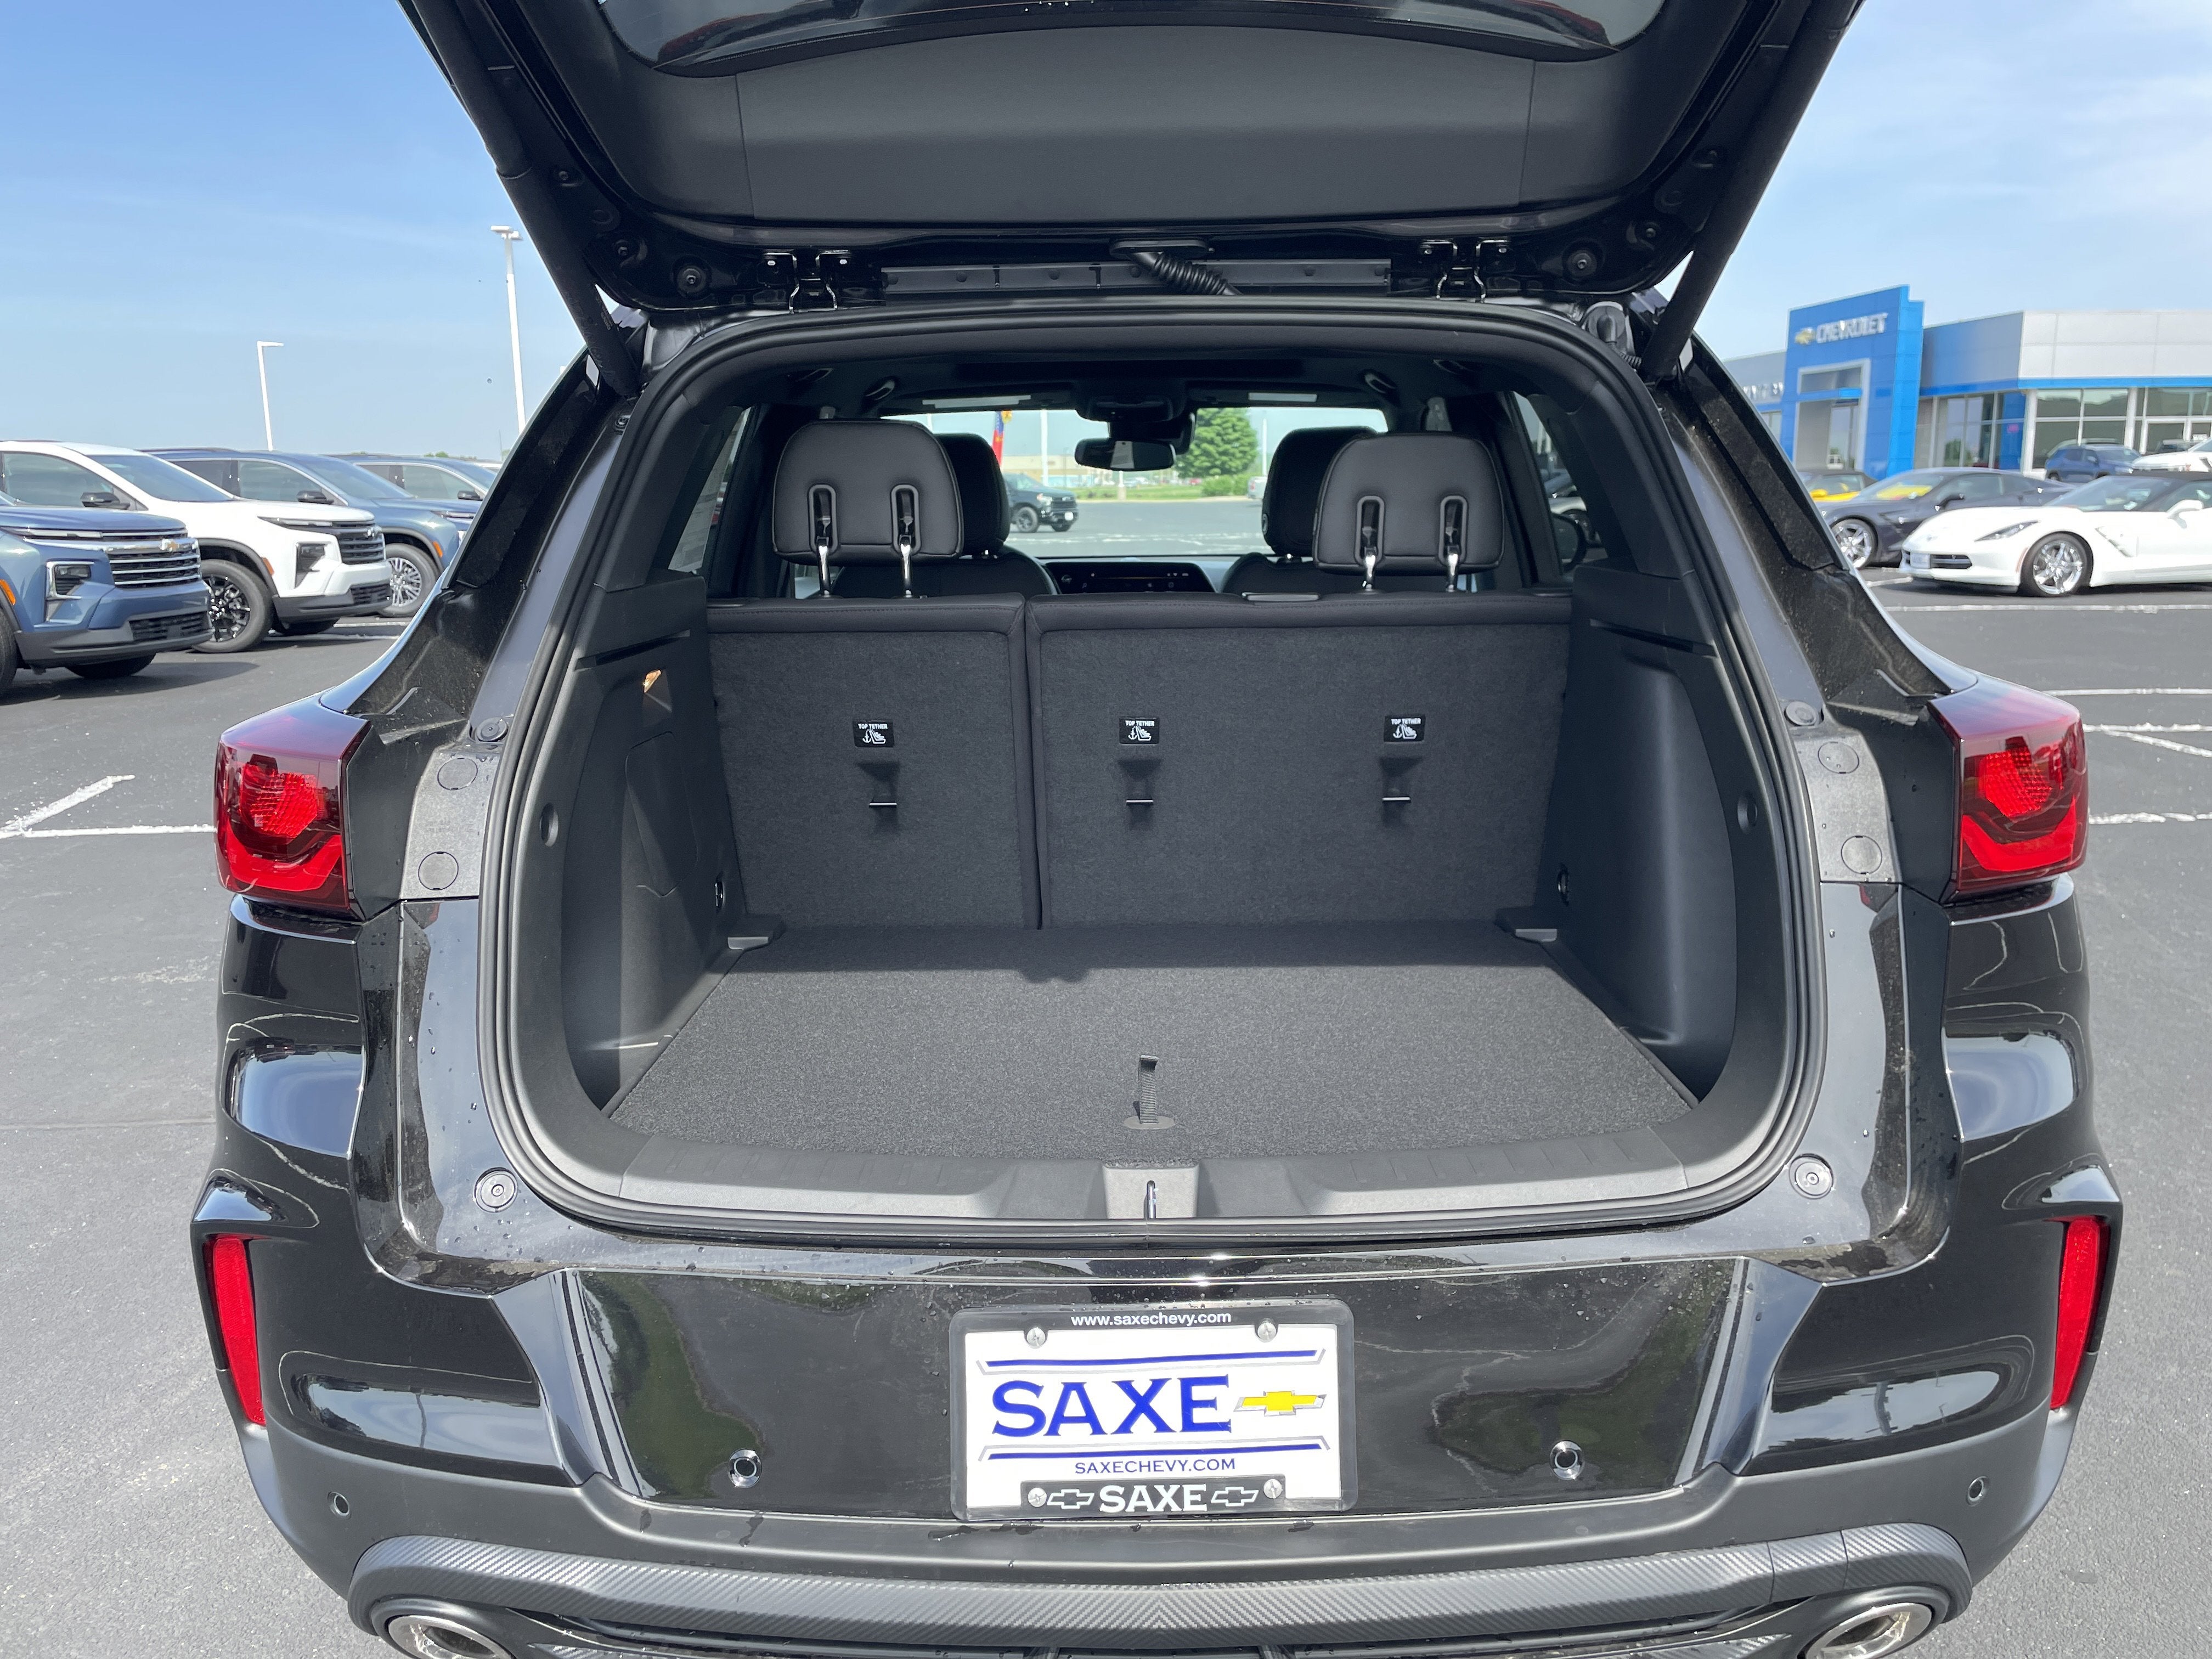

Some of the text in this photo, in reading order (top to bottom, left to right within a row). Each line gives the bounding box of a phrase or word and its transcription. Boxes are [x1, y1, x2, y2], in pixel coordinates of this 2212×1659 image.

[1816, 312, 1888, 344] CHEVROLET
[1070, 1312, 1232, 1327] www.saxechevy.com
[992, 1373, 1232, 1438] SAXE
[1074, 1458, 1236, 1474] SAXECHEVY.COM
[1099, 1483, 1207, 1513] SAXE
